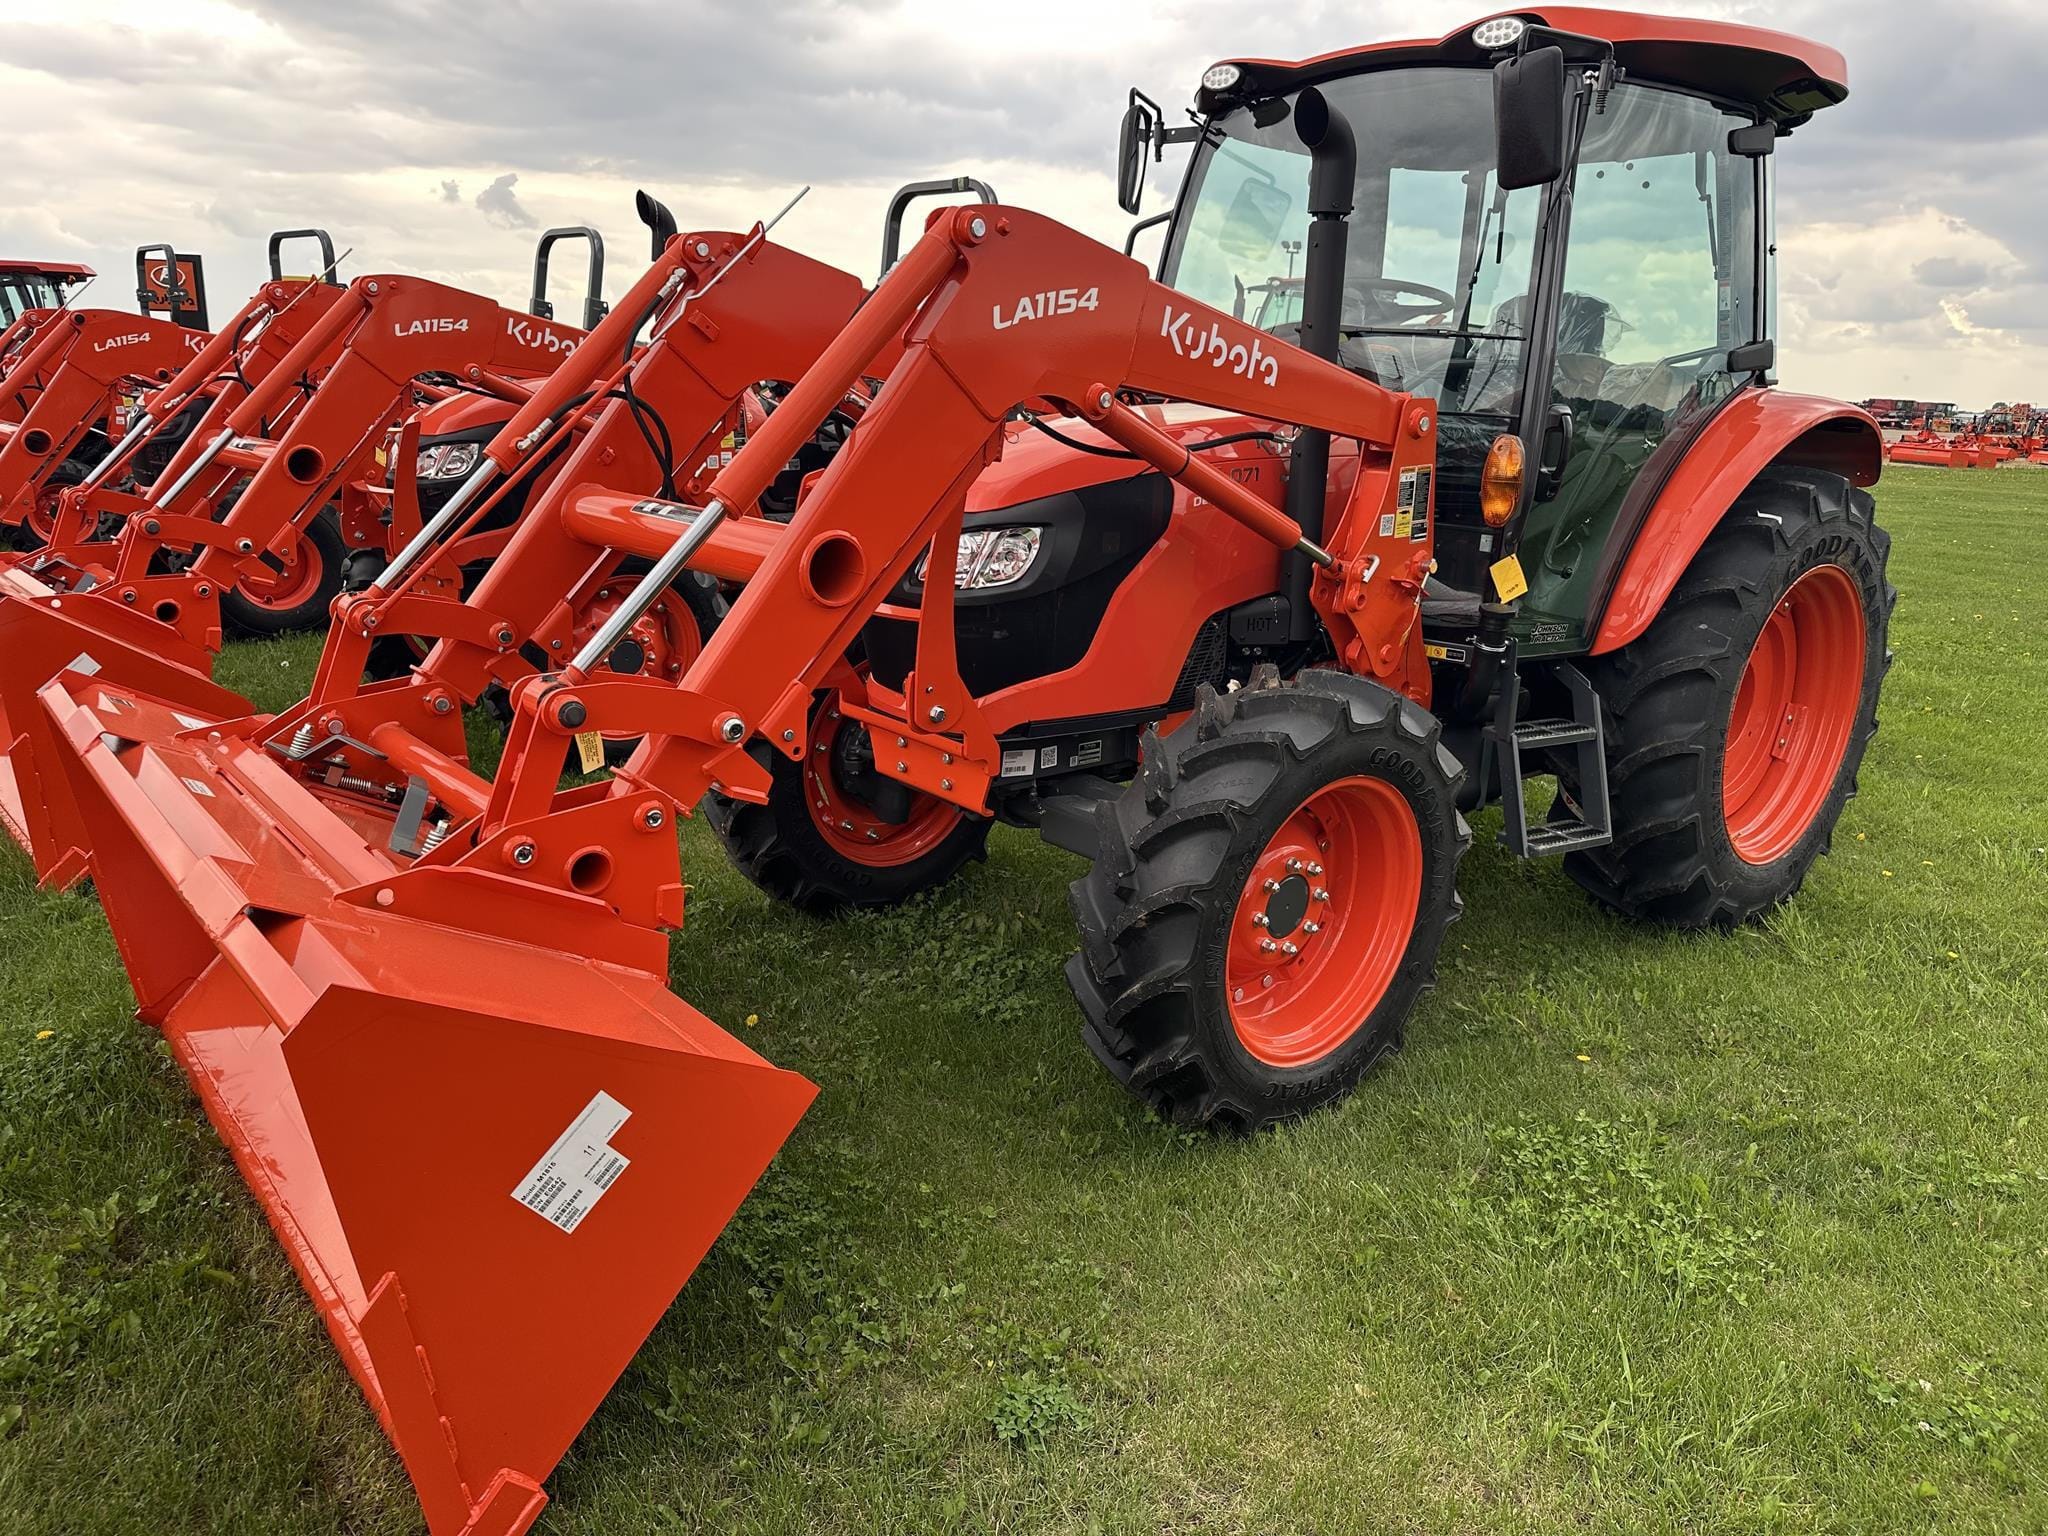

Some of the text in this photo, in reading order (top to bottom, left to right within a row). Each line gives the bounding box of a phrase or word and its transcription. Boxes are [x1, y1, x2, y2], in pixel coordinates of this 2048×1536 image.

[993, 287, 1099, 330] LA1154
[394, 318, 469, 337] LA1154
[94, 332, 151, 352] LA1154
[507, 317, 584, 357] Kubo
[1161, 305, 1279, 387] Kubota
[1247, 617, 1273, 632] HOT
[1531, 623, 1569, 635] JOHNSON
[1530, 634, 1566, 644] TRACTOR
[583, 1145, 596, 1156] 11
[521, 1183, 537, 1201] Model
